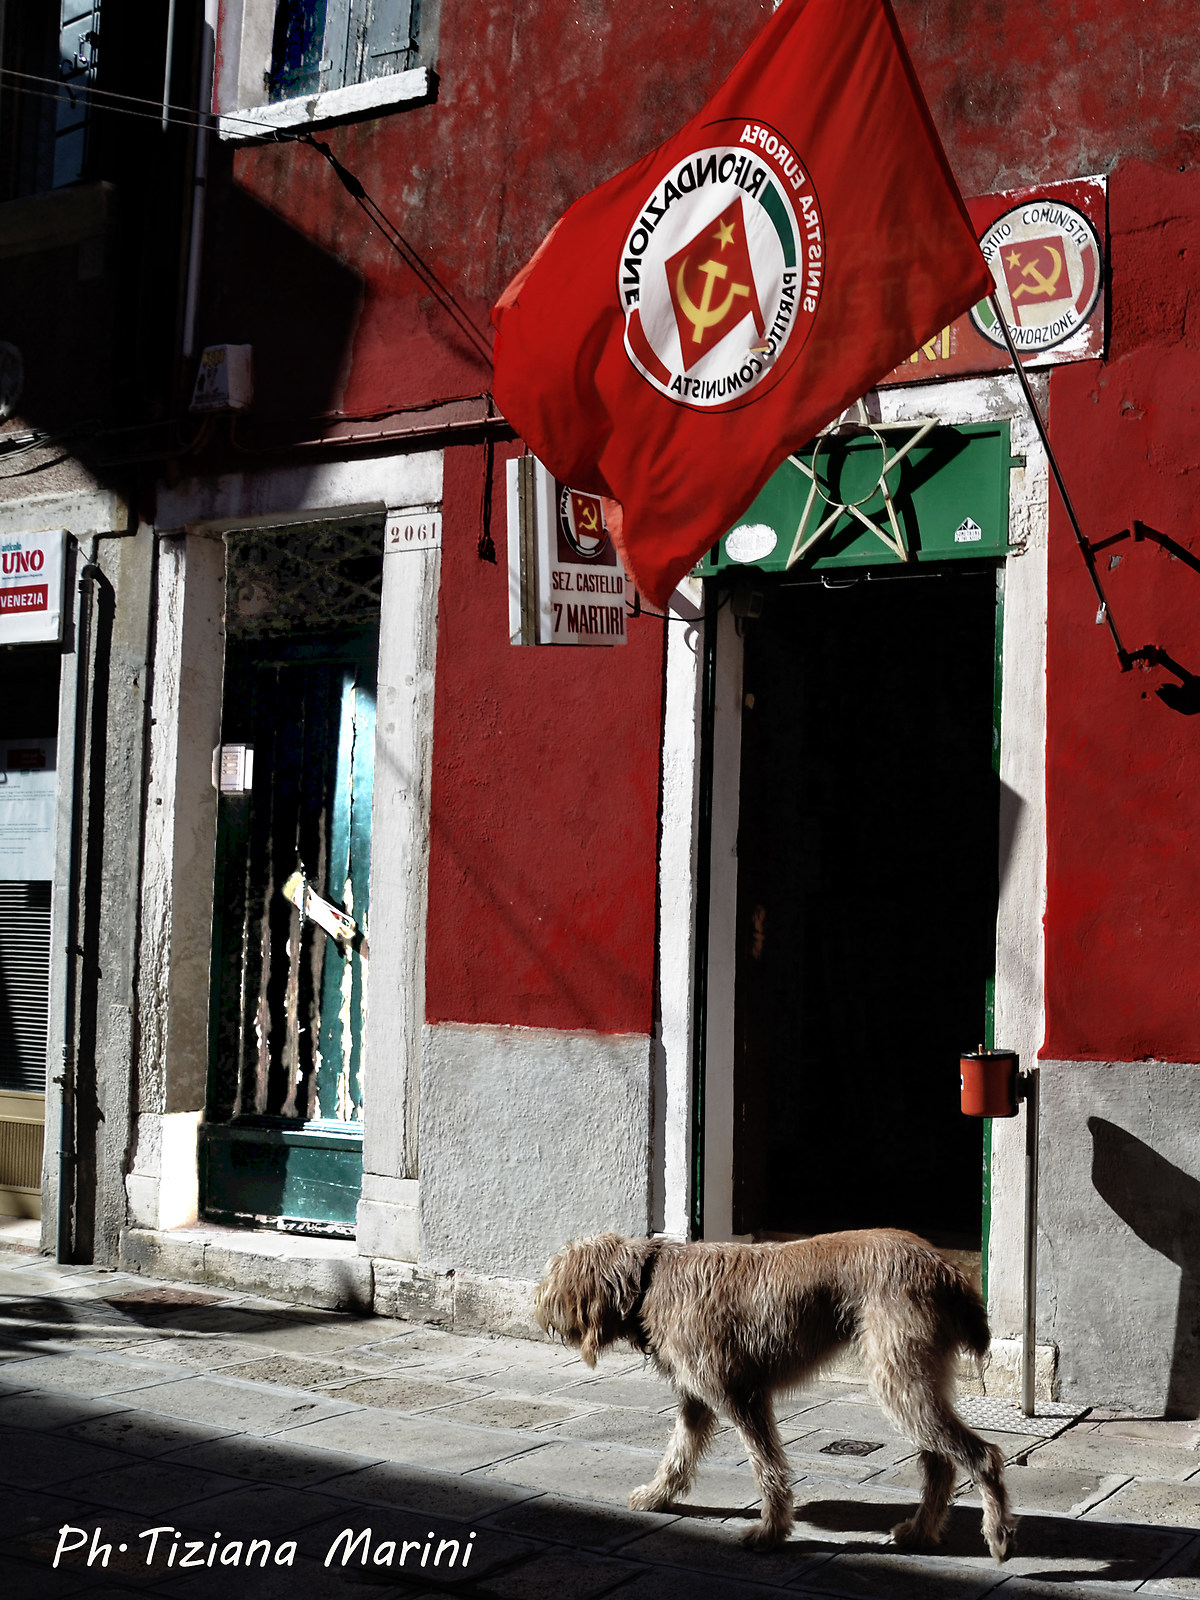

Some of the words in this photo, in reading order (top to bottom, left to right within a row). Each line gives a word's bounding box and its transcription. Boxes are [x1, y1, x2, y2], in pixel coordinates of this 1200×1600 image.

[983, 223, 1011, 265] ARTITO
[1022, 208, 1088, 247] COMUNISTA
[991, 310, 1076, 345] RONDAZIONE
[391, 522, 436, 543] 2061
[2, 549, 45, 574] UNO
[552, 571, 574, 591] SEZ.
[576, 573, 623, 594] CASTELLO
[0, 592, 44, 608] VENEZIA
[553, 603, 563, 633] 7
[567, 604, 624, 635] MARTIRI
